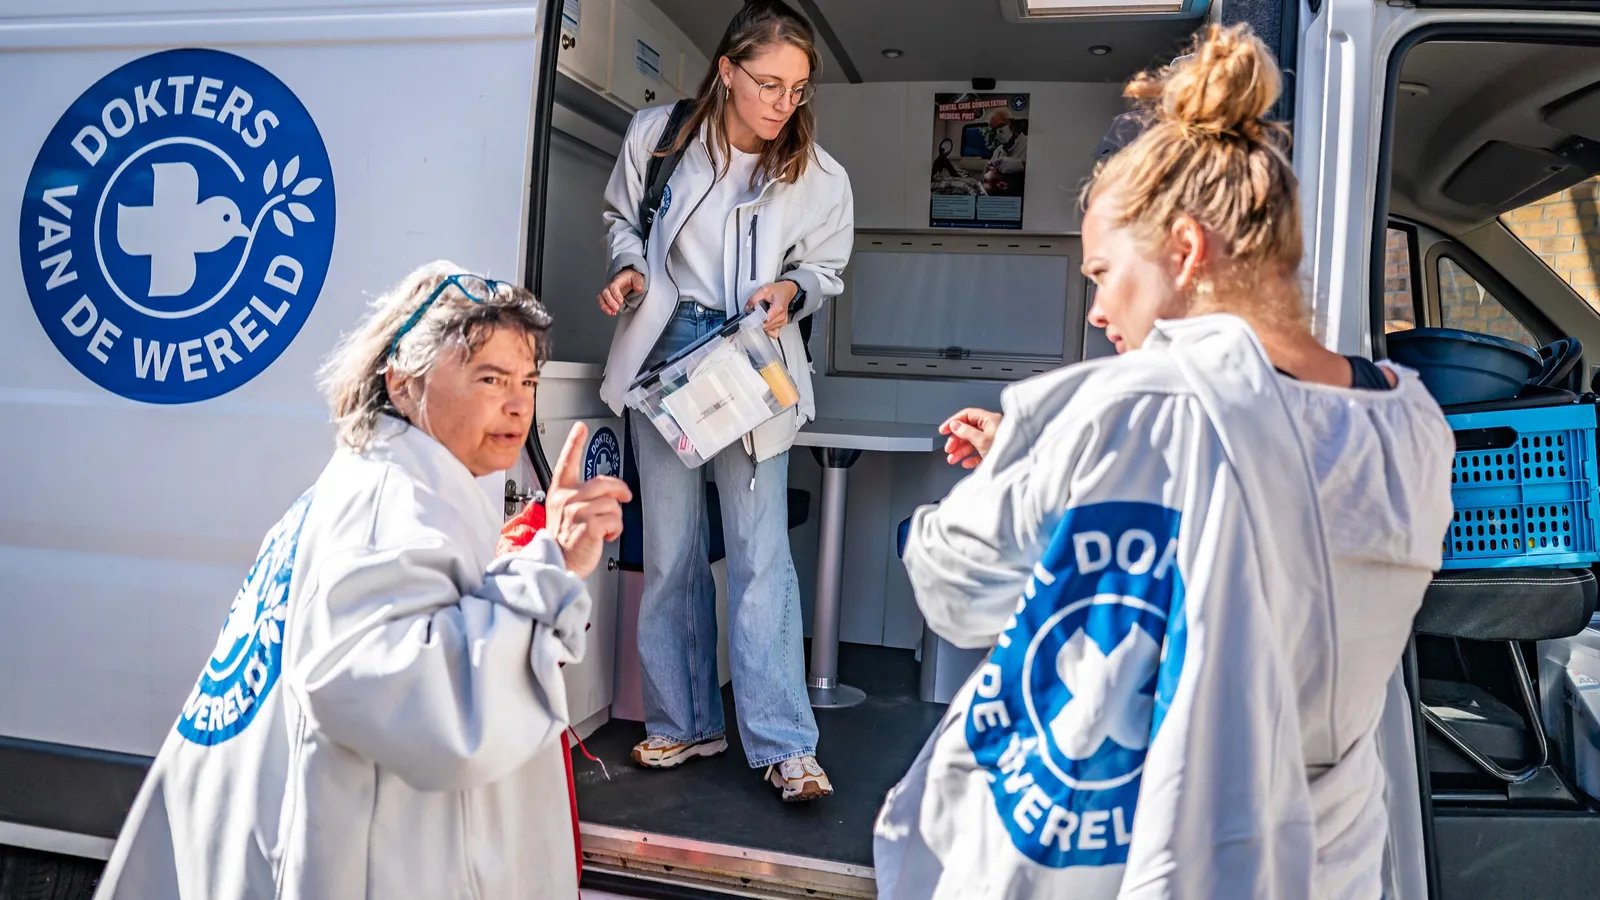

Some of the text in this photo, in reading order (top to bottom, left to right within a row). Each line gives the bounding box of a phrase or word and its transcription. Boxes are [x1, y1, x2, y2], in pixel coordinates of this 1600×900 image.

[71, 75, 279, 166] DOKTERS
[939, 103, 957, 111] DENTAL
[958, 102, 971, 110] CARE
[972, 100, 1007, 108] CONSULTATION
[38, 185, 303, 382] VAN DE WERELD
[591, 433, 615, 455] DOKTERS
[973, 662, 1011, 732] DE
[997, 732, 1133, 852] WEREL
